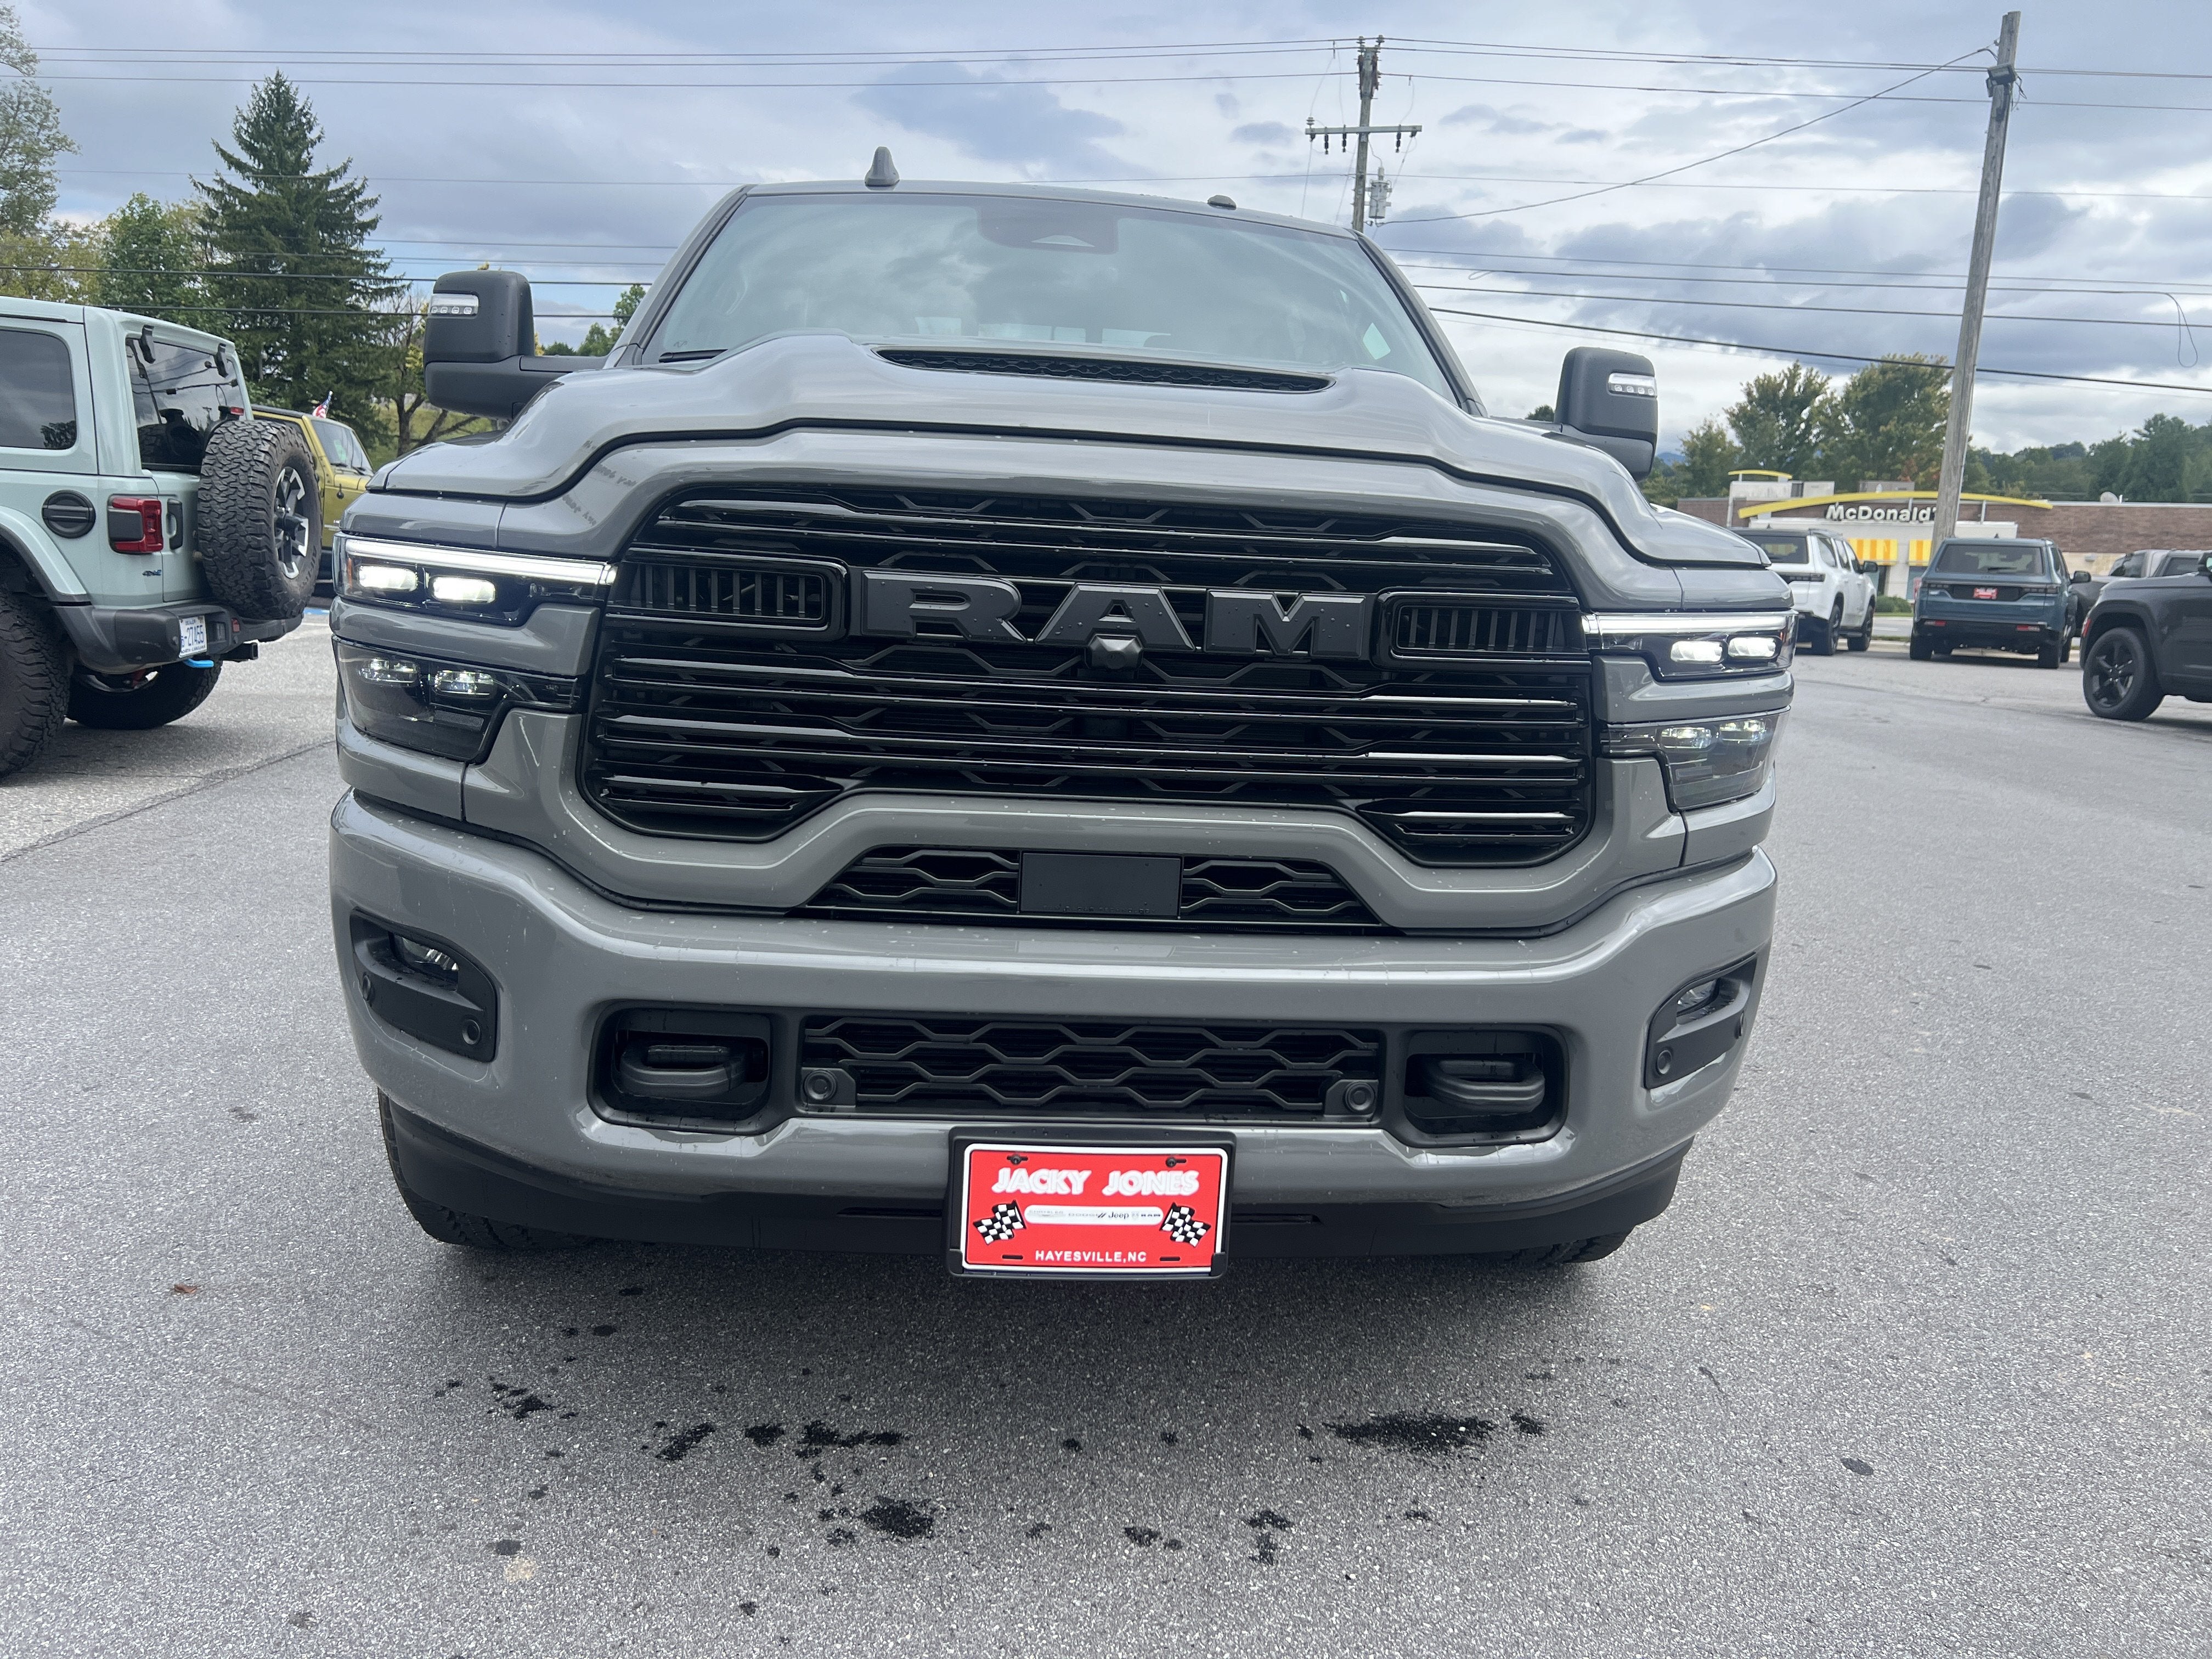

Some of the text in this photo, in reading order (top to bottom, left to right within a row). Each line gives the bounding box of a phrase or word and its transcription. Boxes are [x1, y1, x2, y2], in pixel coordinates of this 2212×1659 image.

[1826, 504, 1937, 521] McDonald'
[861, 569, 1366, 657] RAM
[992, 1168, 1199, 1197] JACKY JONES
[1108, 1211, 1129, 1220] Jeep
